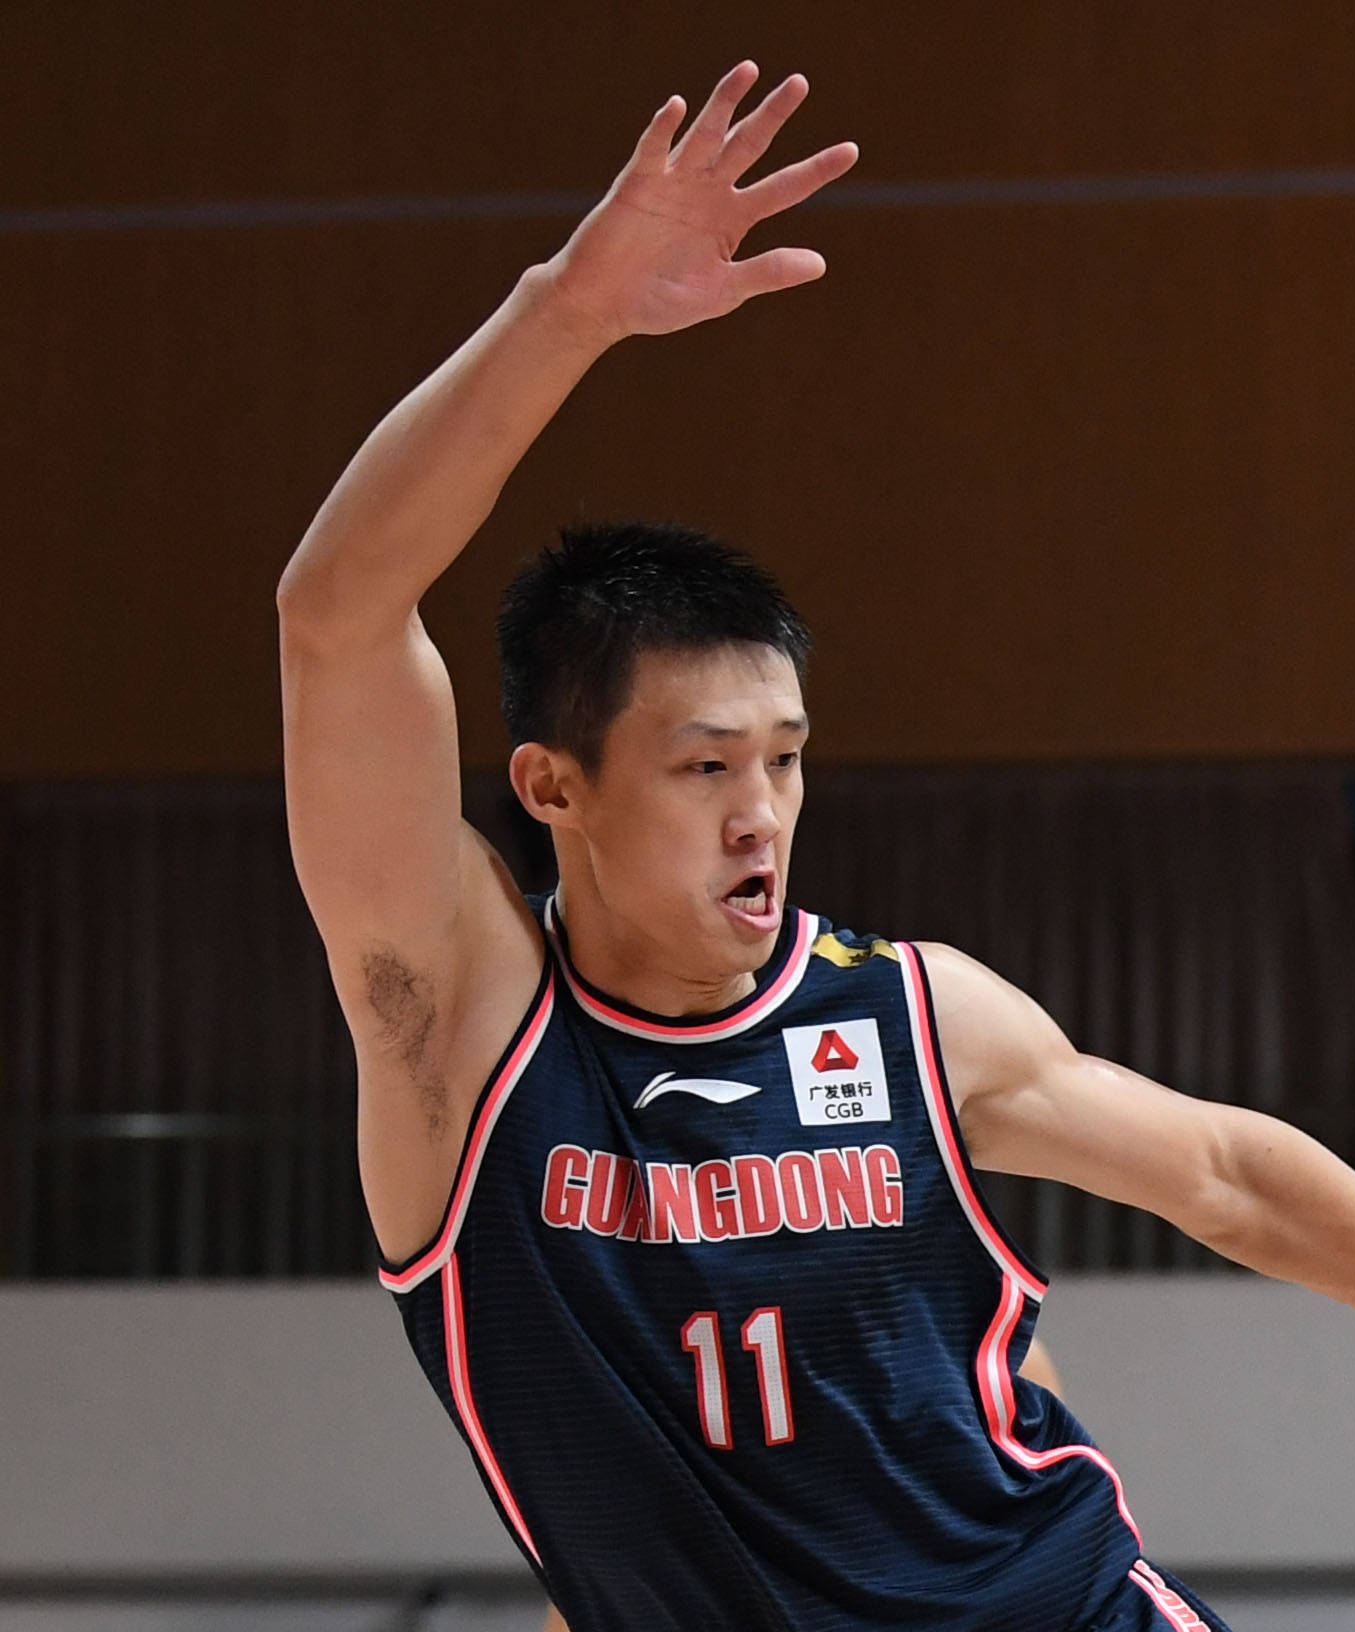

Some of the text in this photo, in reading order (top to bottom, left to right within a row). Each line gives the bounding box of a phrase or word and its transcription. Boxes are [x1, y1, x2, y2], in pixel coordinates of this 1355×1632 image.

[809, 1081, 872, 1101] 广发银行
[824, 1101, 864, 1119] CGB
[541, 1144, 904, 1244] GUANGDONG
[680, 1305, 795, 1450] 11
